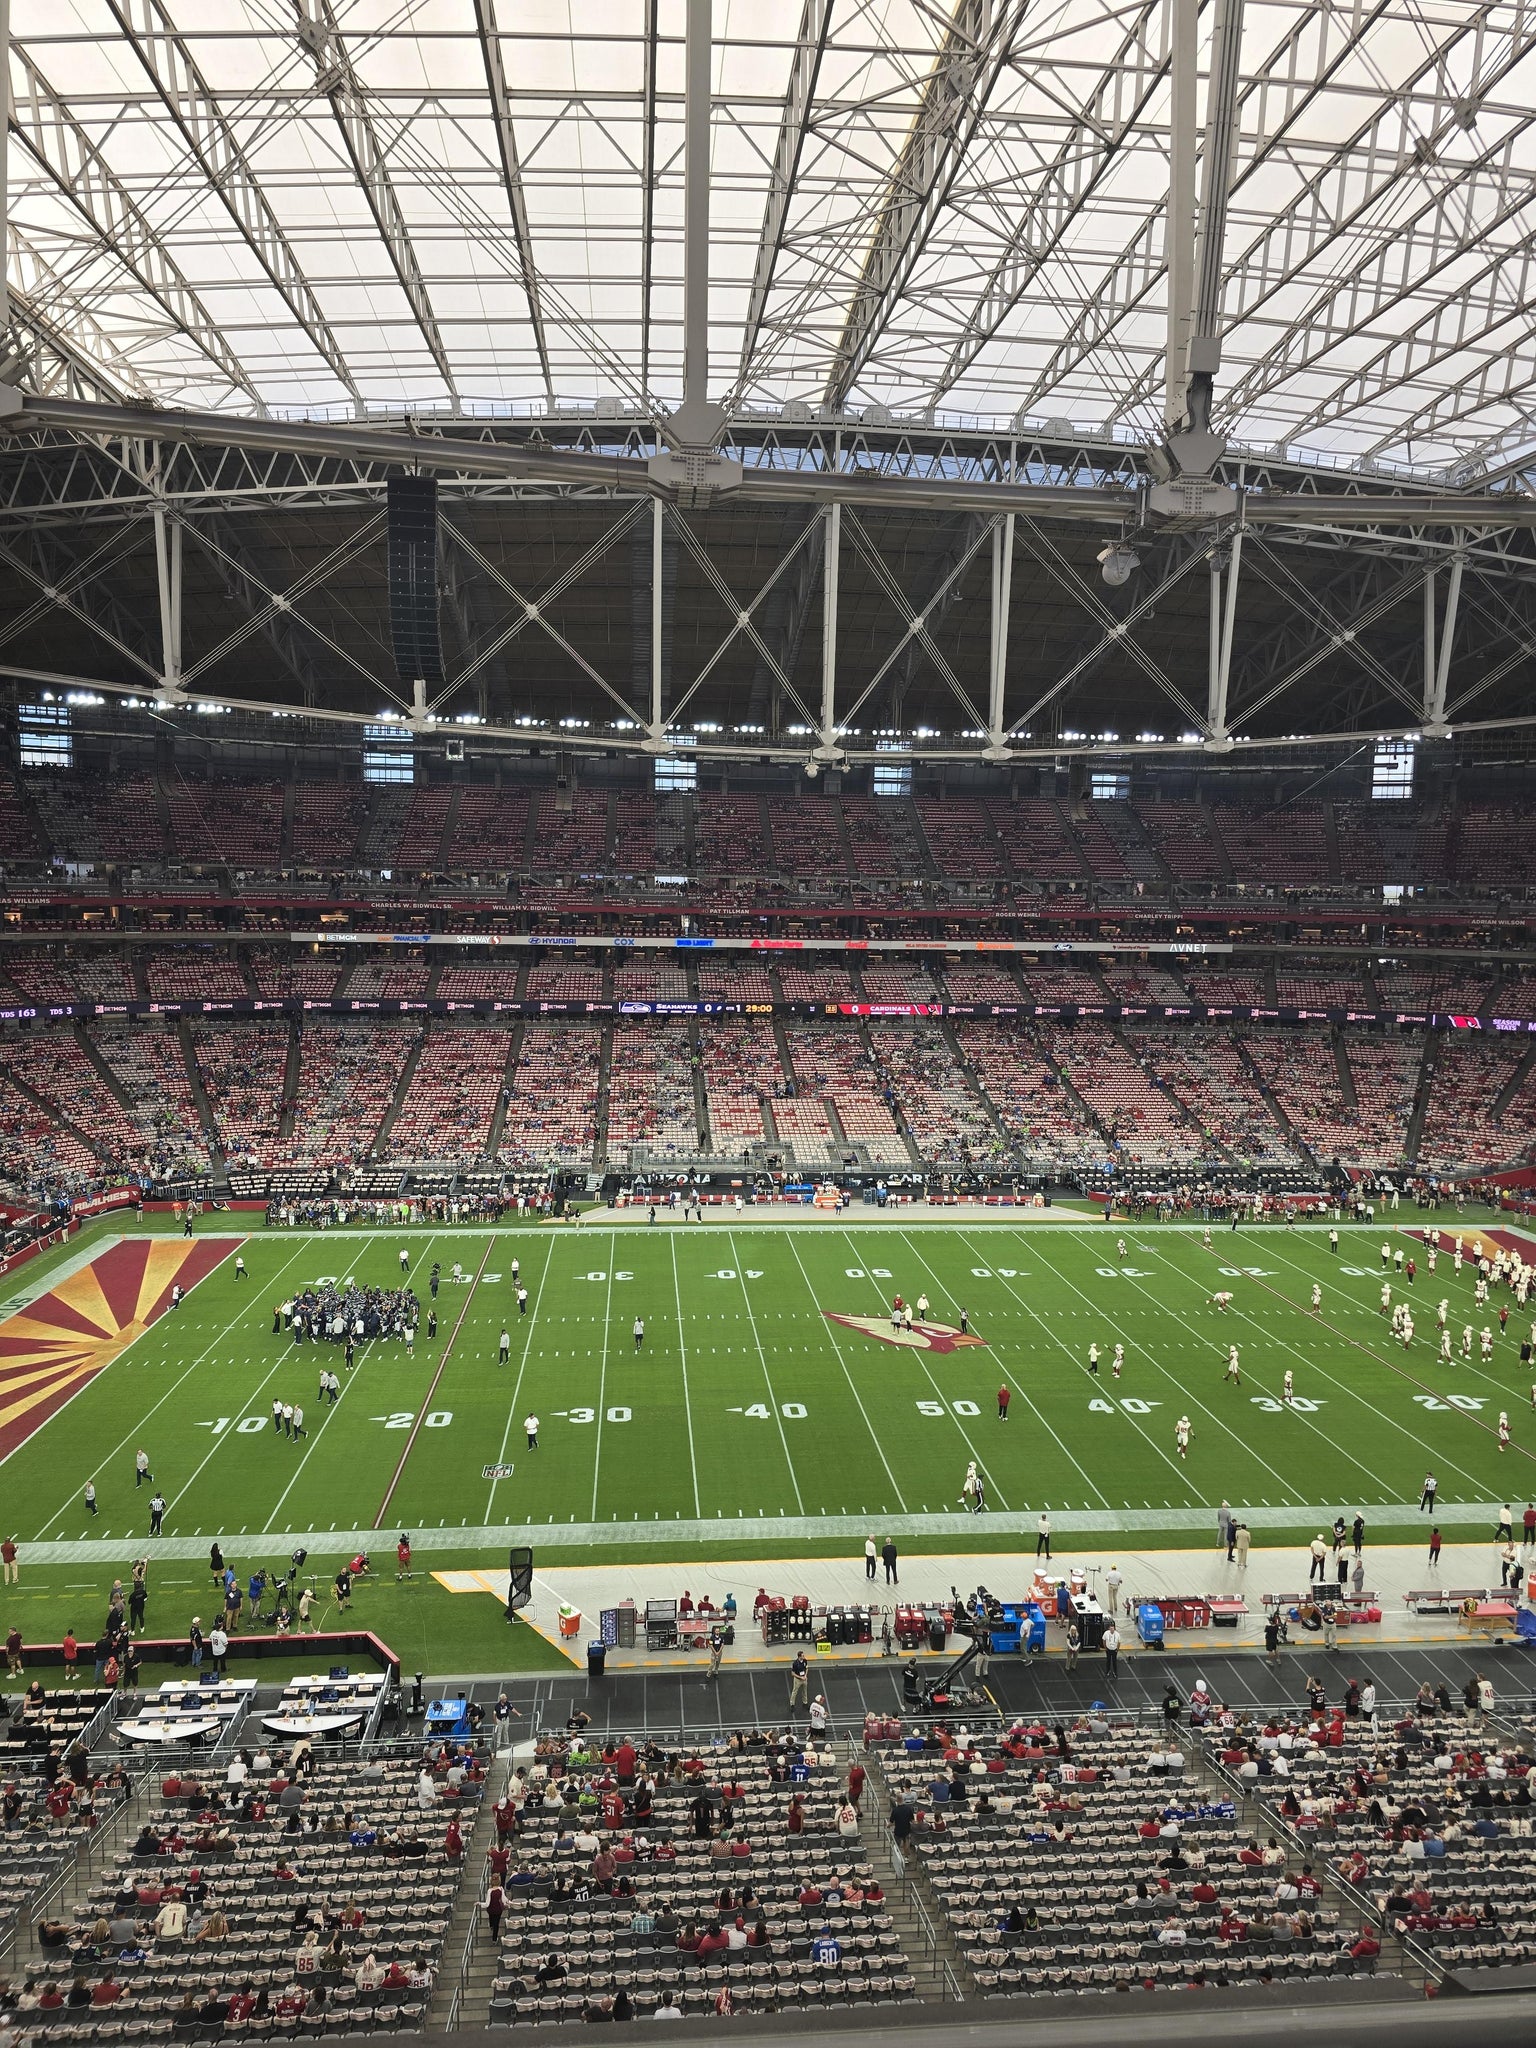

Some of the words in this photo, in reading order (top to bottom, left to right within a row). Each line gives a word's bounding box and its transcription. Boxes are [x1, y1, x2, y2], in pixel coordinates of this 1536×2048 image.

[456, 935, 490, 944] SAFEWAY
[1169, 943, 1207, 953] AVNET
[18, 1008, 36, 1018] 163
[66, 1006, 73, 1015] 3
[705, 1003, 712, 1012] 0
[736, 1004, 741, 1012] 1
[745, 1004, 773, 1012] 29:00
[851, 1005, 859, 1013] 0
[1492, 1018, 1521, 1026] SEASON
[1088, 1398, 1152, 1414] 40
[1250, 1396, 1319, 1412] 30
[1412, 1394, 1484, 1410] 20
[744, 1403, 808, 1419] 40
[915, 1400, 982, 1416] 50
[384, 1411, 454, 1428] 20
[569, 1406, 632, 1423] 30
[210, 1416, 269, 1434] 10
[486, 1469, 511, 1478] NFL
[1041, 1600, 1052, 1613] G
[560, 1618, 566, 1629] G
[1224, 1716, 1234, 1725] 68
[302, 1760, 309, 1773] 11
[796, 1773, 803, 1782] 11
[1064, 1771, 1074, 1782] 18
[58, 1799, 63, 1807] 1
[606, 1804, 615, 1816] 31
[841, 1808, 854, 1824] 85
[189, 1894, 194, 1903] 1
[575, 1891, 589, 1901] 40
[1301, 1889, 1314, 1899] 85
[172, 1912, 176, 1926] 1
[819, 1947, 838, 1964] 80
[298, 1957, 314, 1972] 85
[414, 1978, 425, 1987] 85
[232, 2008, 240, 2021] 3
